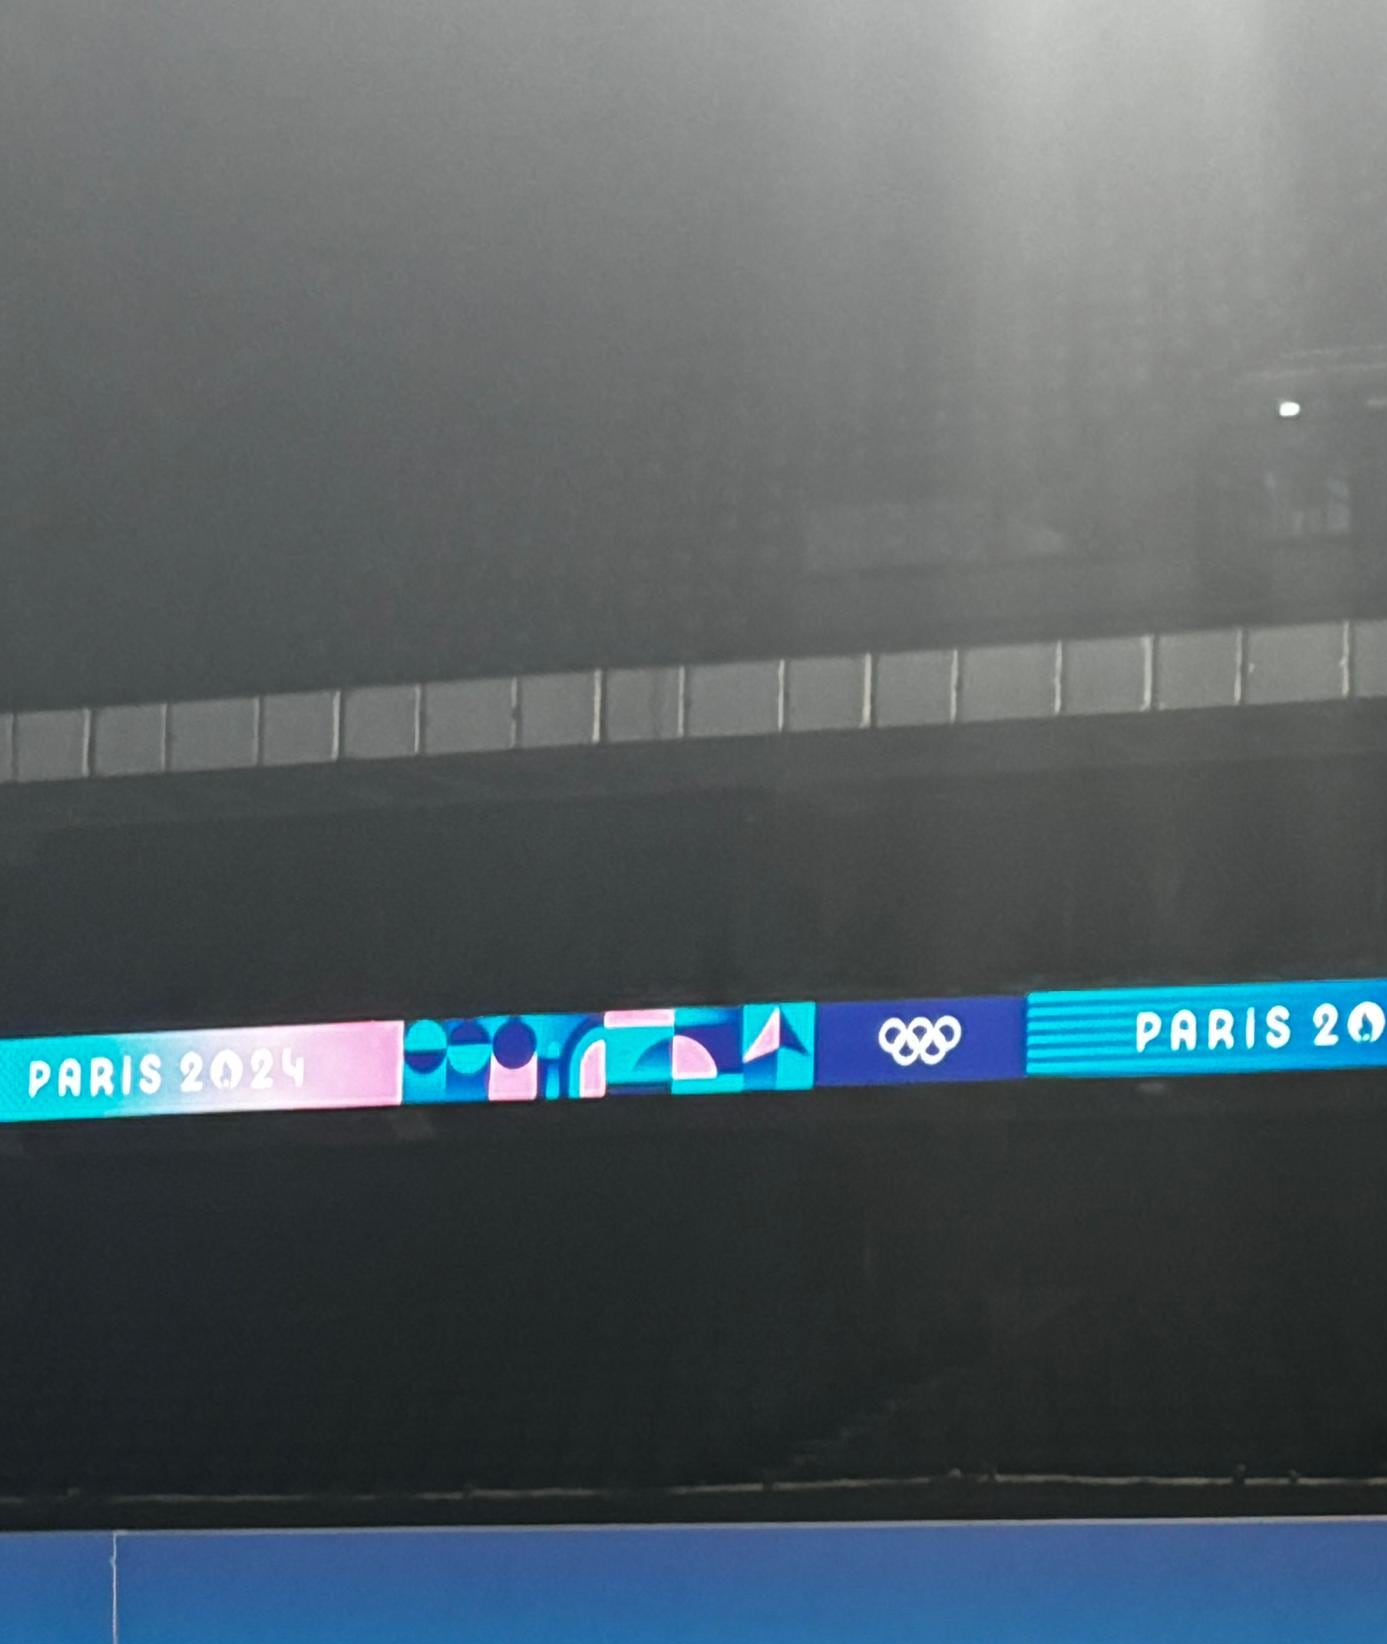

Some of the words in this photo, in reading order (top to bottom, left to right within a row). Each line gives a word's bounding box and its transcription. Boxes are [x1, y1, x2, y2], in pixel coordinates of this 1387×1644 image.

[1136, 1005, 1291, 1053] PARIS
[28, 1054, 162, 1098] PARIS
[179, 1048, 305, 1093] 2024
